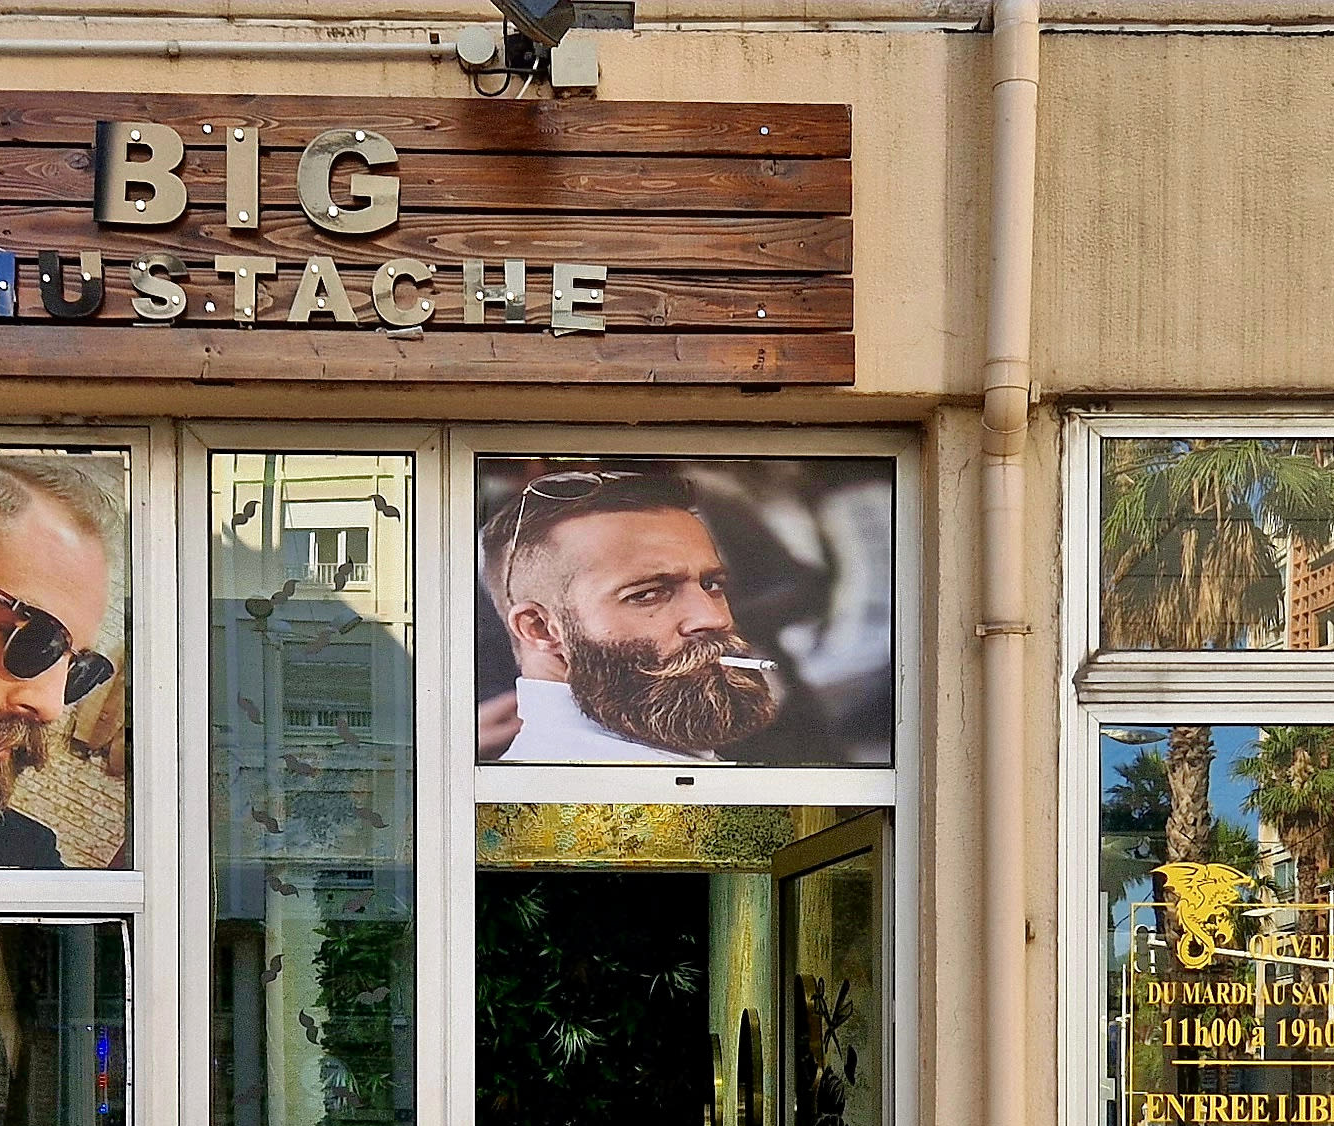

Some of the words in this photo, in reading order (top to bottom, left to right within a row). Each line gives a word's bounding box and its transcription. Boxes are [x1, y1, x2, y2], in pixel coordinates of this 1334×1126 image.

[93, 119, 402, 234] BIG
[1147, 982, 1179, 1006] DU
[1182, 981, 1255, 1006] MARDI
[1257, 982, 1286, 1006] AU
[1162, 1018, 1241, 1048] 11h00
[1251, 1020, 1266, 1047] à
[1146, 1093, 1269, 1123] ENTREE
